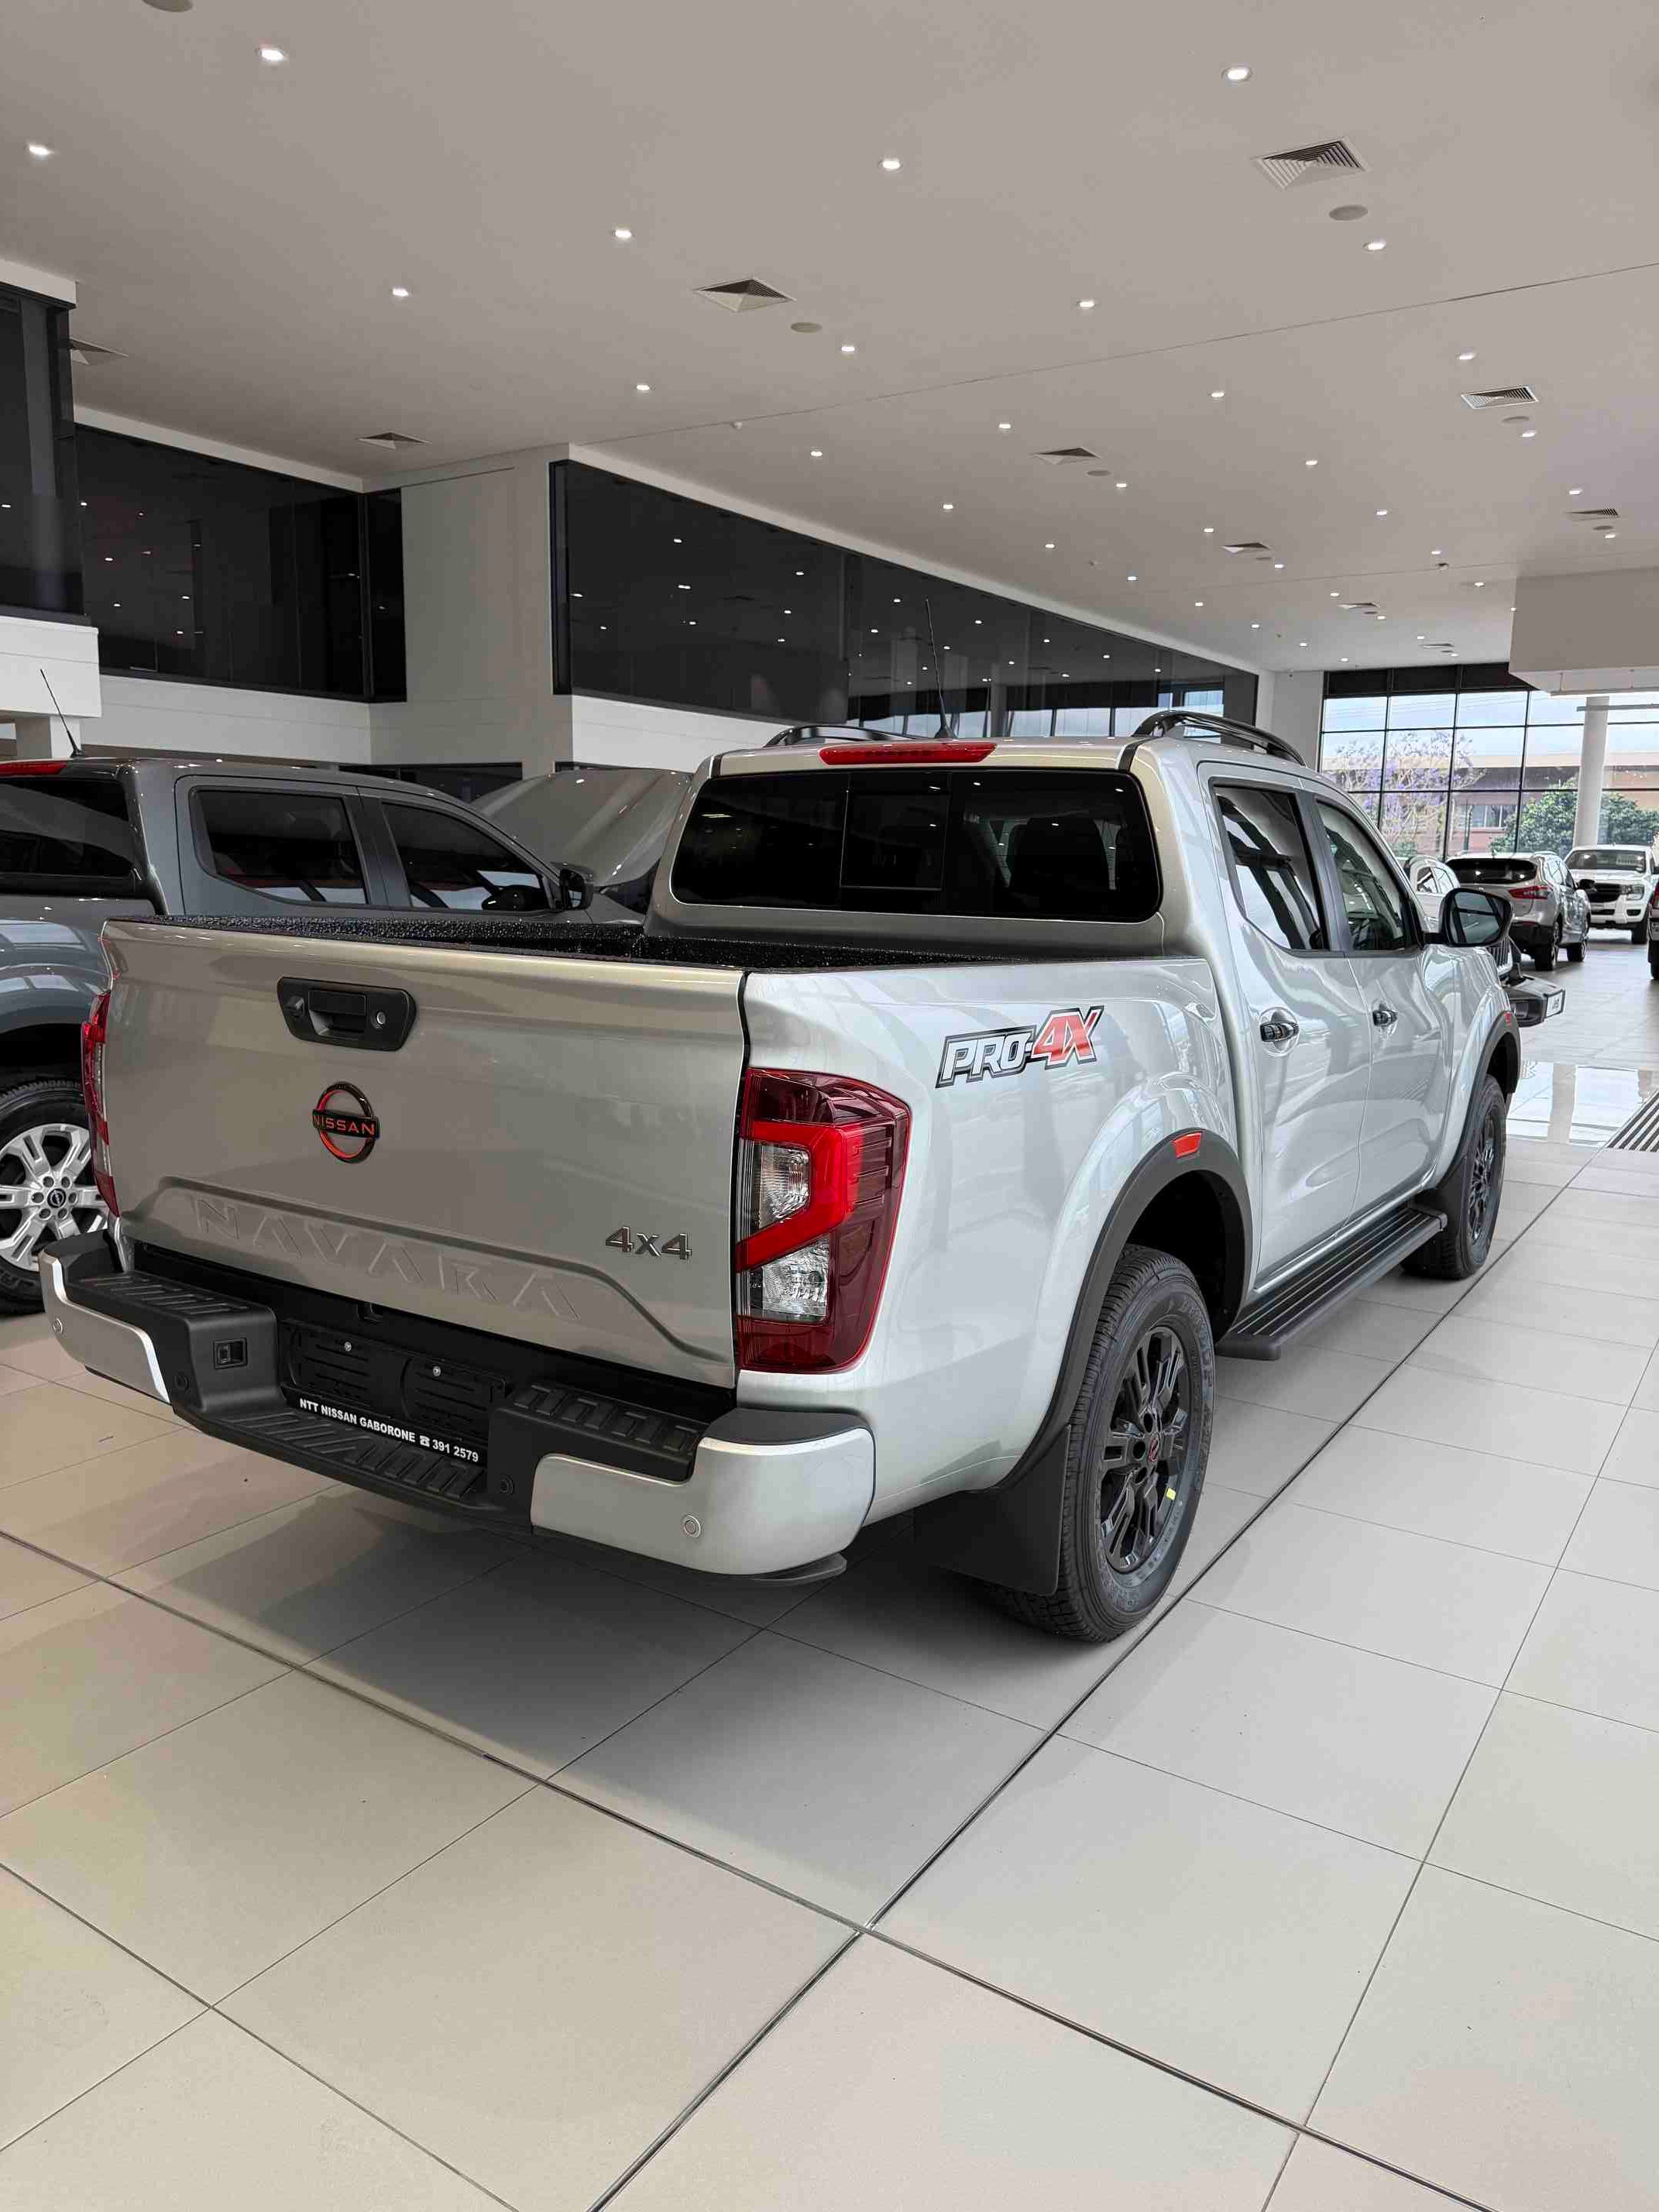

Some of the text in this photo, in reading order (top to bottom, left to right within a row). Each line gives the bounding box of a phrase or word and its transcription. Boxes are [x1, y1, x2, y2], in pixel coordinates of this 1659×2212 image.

[935, 1005, 1105, 1089] PRO-4X
[312, 1114, 376, 1136] NISSAN
[194, 1199, 581, 1321] NAVARA
[299, 1398, 479, 1463] NTT NISSAN GABORONE 391 2579
